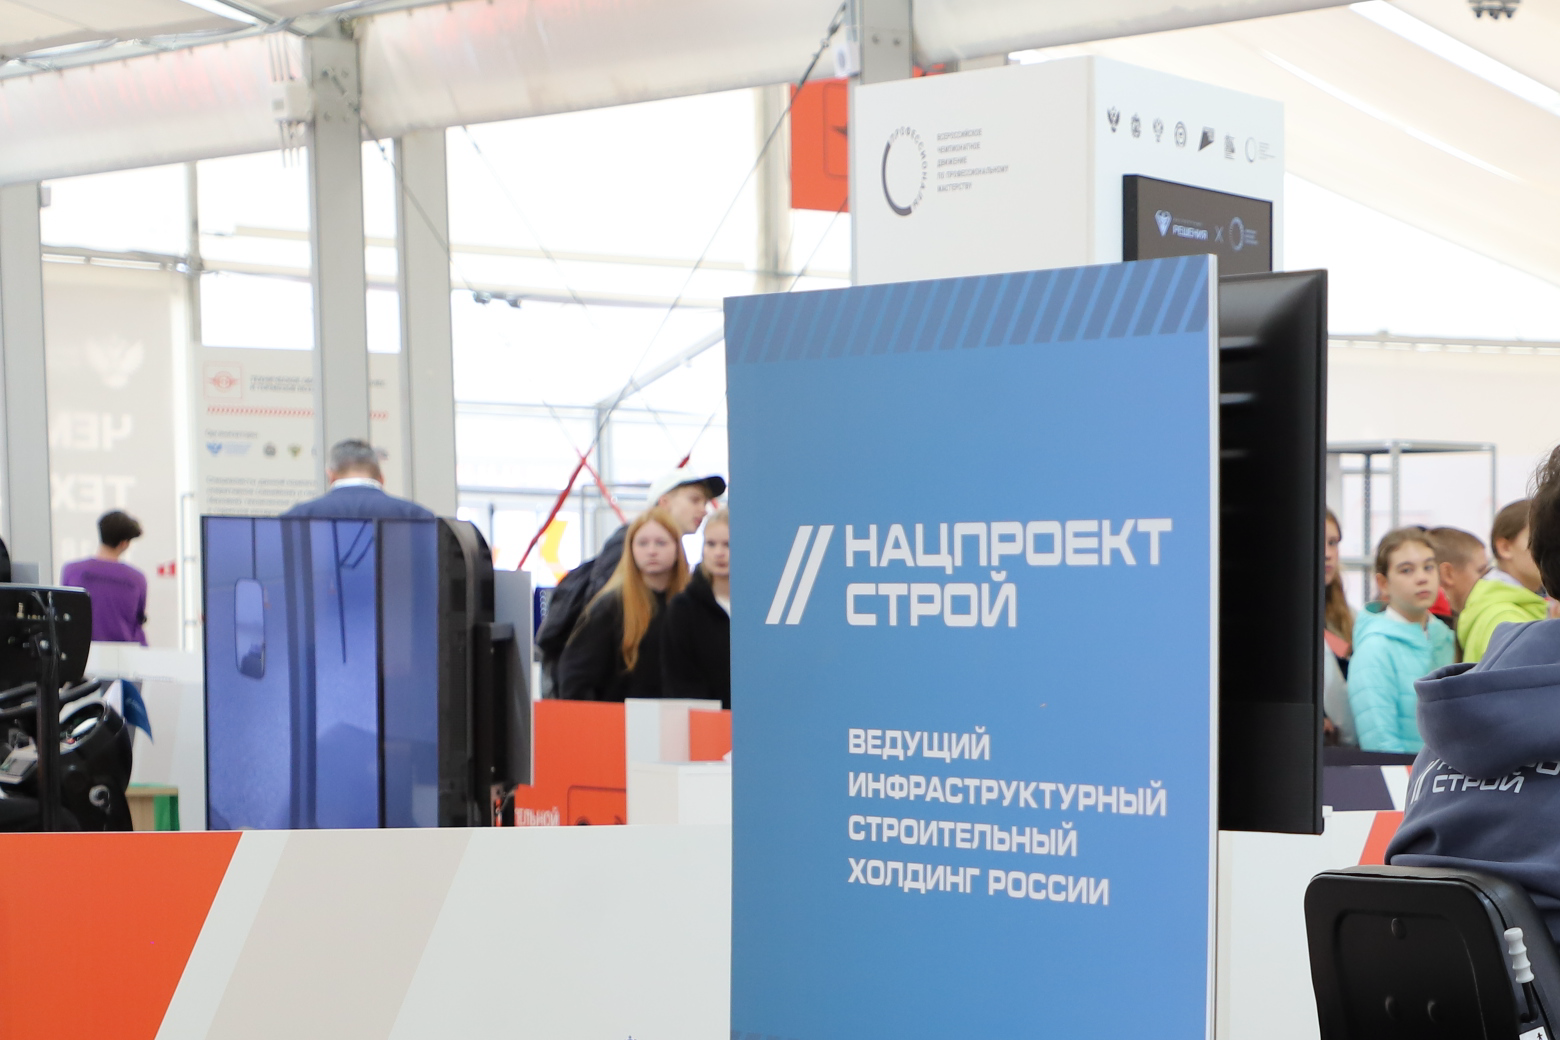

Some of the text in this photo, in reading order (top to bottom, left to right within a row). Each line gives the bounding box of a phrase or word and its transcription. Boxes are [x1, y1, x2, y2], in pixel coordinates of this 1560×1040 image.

[845, 518, 1173, 575] НАЦПРОЕКТ
[846, 570, 1018, 628] СТРОЙ
[848, 725, 991, 764] ВЕДУЩИЙ
[848, 771, 1167, 817] ИНФРАСТРУКТУРНЫЙ
[1432, 771, 1525, 793] СТРОЙ
[848, 814, 1078, 857] СТРОИТЕЛЬНЫЙ
[848, 857, 1109, 906] ХОЛДИНГ РОССИИ
